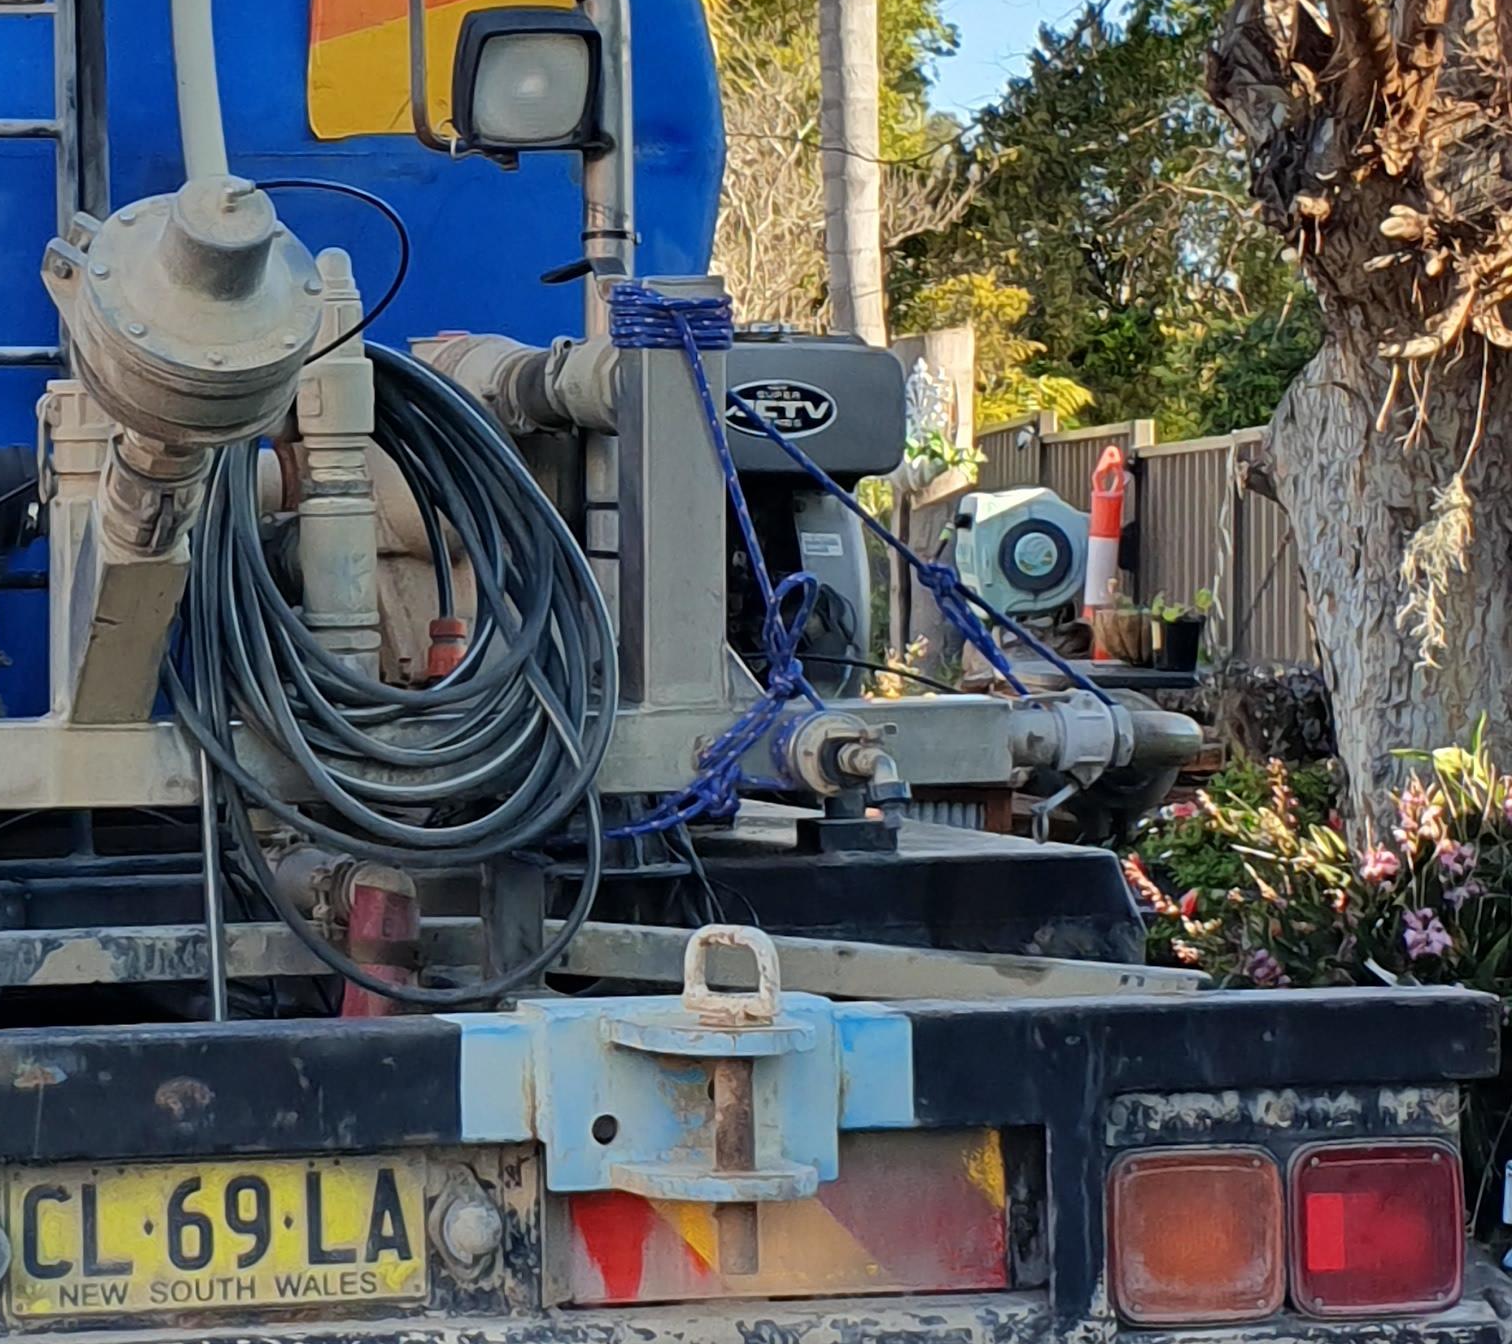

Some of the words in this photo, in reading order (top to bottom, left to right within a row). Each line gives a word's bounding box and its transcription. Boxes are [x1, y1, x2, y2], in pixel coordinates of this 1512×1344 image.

[59, 1281, 129, 1307] NEW
[149, 1274, 256, 1305] SOUTH
[274, 1270, 378, 1297] WALES
